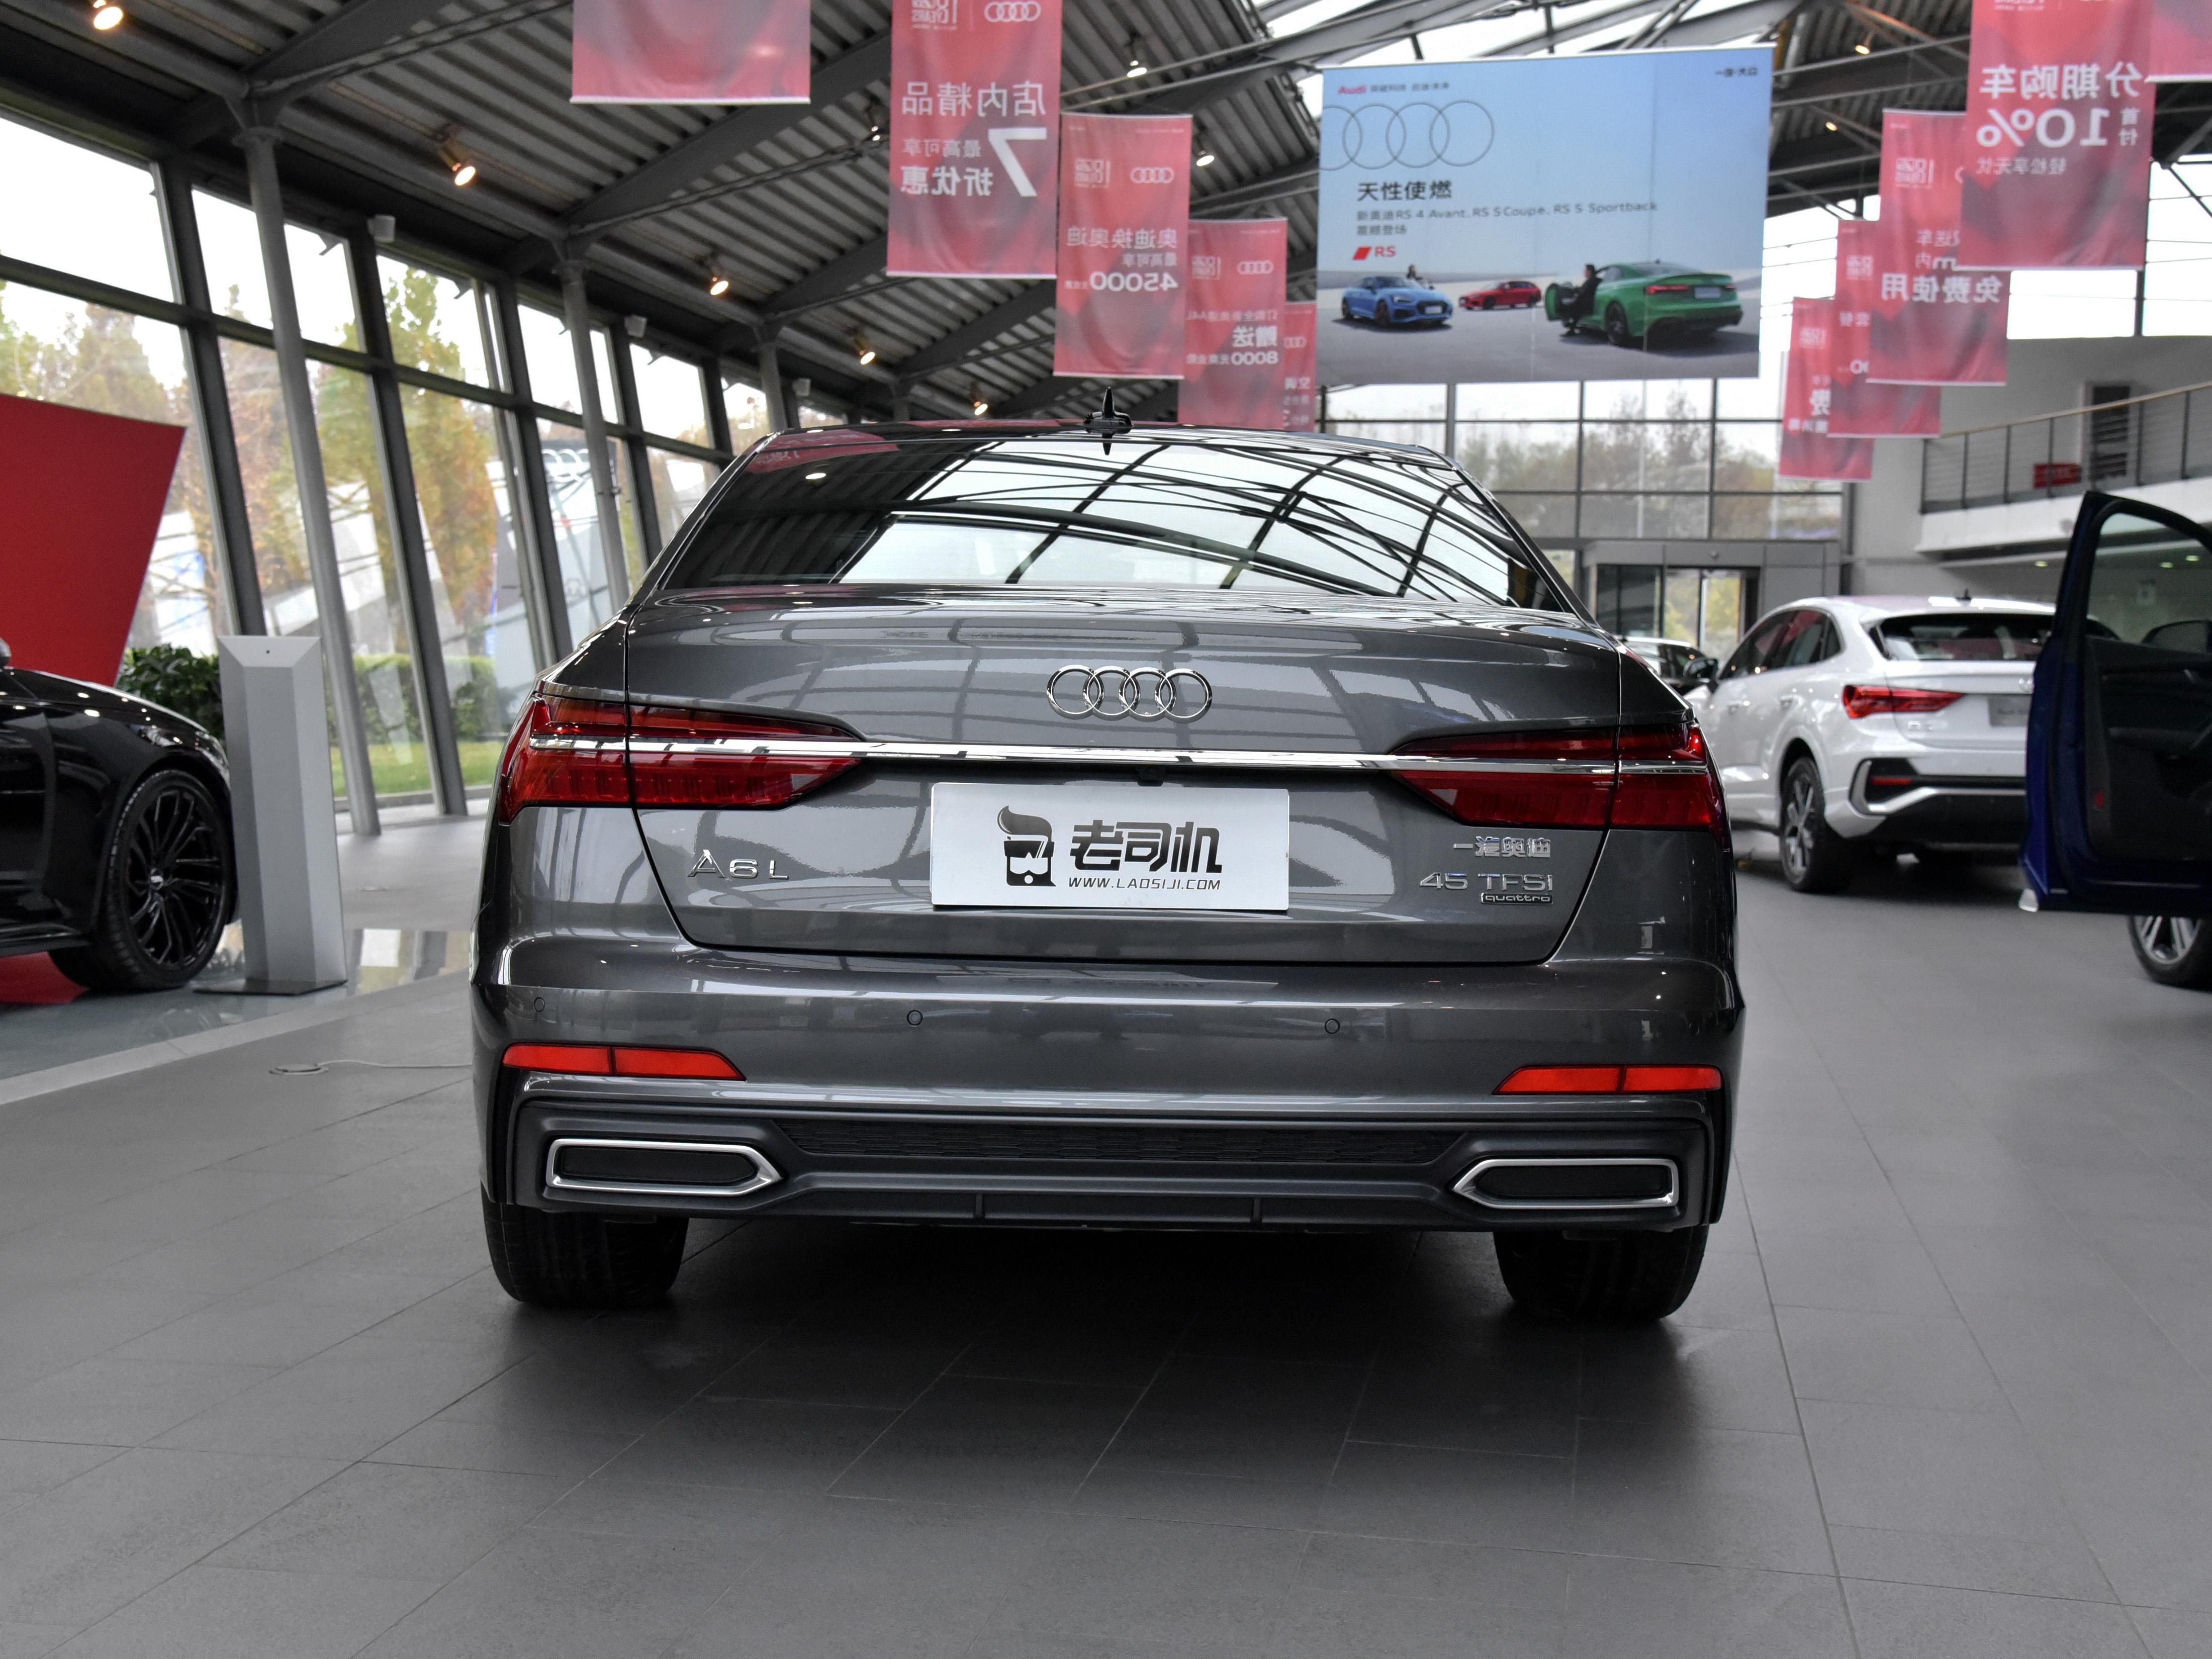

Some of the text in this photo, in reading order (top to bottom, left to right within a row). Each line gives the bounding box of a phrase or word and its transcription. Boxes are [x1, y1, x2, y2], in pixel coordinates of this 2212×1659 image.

[1358, 179, 1453, 202] 天性使燃
[1553, 203, 1571, 214] RS
[1587, 202, 1657, 215] Sportback
[1374, 245, 1397, 257] RS
[1069, 819, 1223, 874] 老司机
[1453, 836, 1551, 858] 一汽奥迪
[1069, 877, 1221, 890] WWW.LAOSIJI.COM
[1419, 872, 1468, 890] 45
[1485, 894, 1550, 902] quattro
